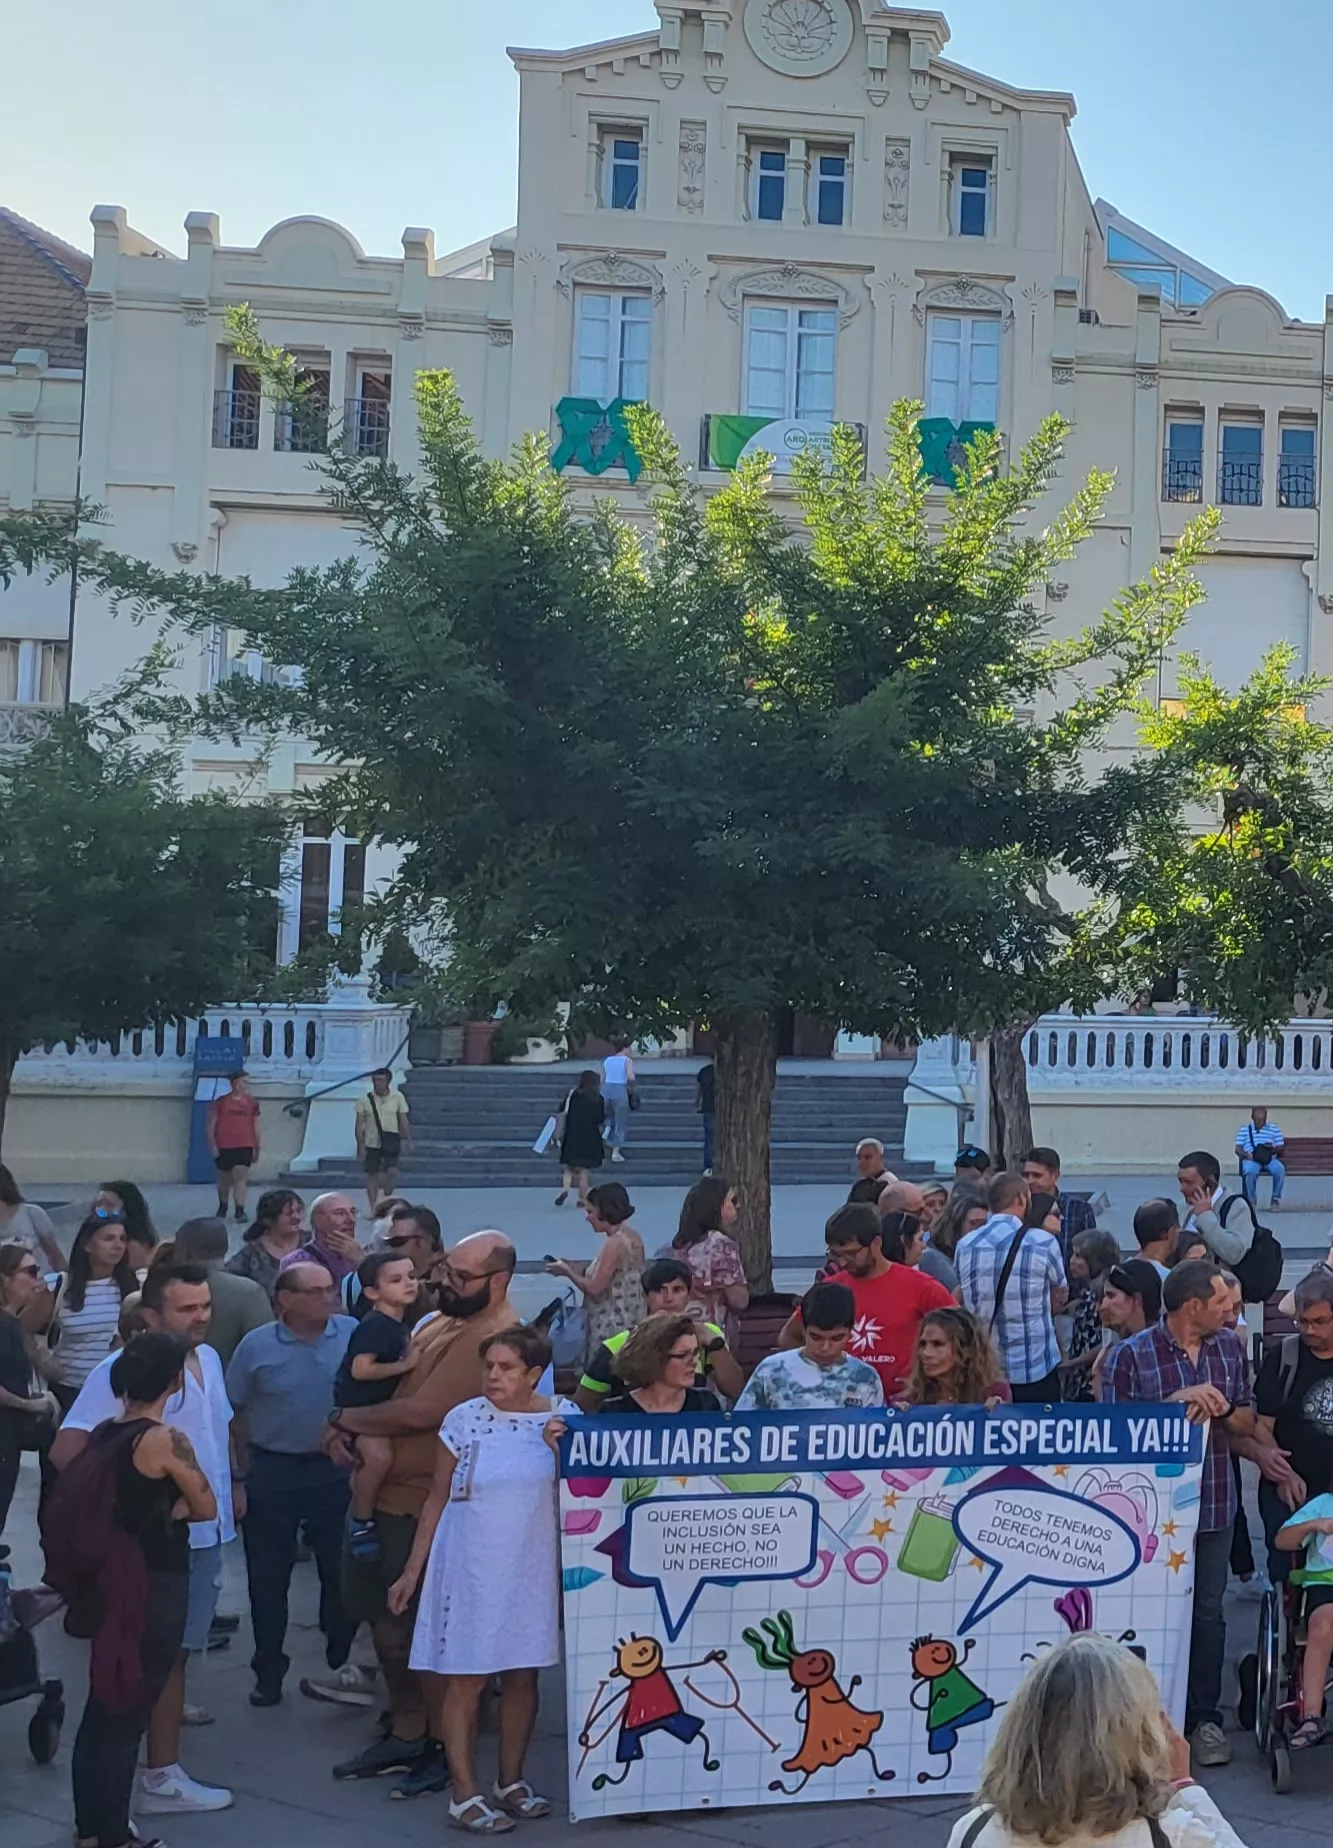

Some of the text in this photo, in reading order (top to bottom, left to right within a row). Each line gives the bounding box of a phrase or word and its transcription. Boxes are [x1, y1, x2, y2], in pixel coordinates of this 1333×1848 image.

[568, 1414, 1190, 1467] AUXILIARES DE EDUCACIÓN ESPECIAL YA!!!
[647, 1506, 798, 1522] QUEREMOS QUE LA
[994, 1499, 1112, 1541] TODOS TENEMOS
[662, 1523, 782, 1539] INCLUSIÓN SEA
[991, 1516, 1103, 1556] DERECHO A UNA
[664, 1539, 778, 1554] UN HECHO, NO
[977, 1529, 1106, 1574] EDUCACIÓN DIGNA
[662, 1556, 778, 1571] UN DERECHO!!!
